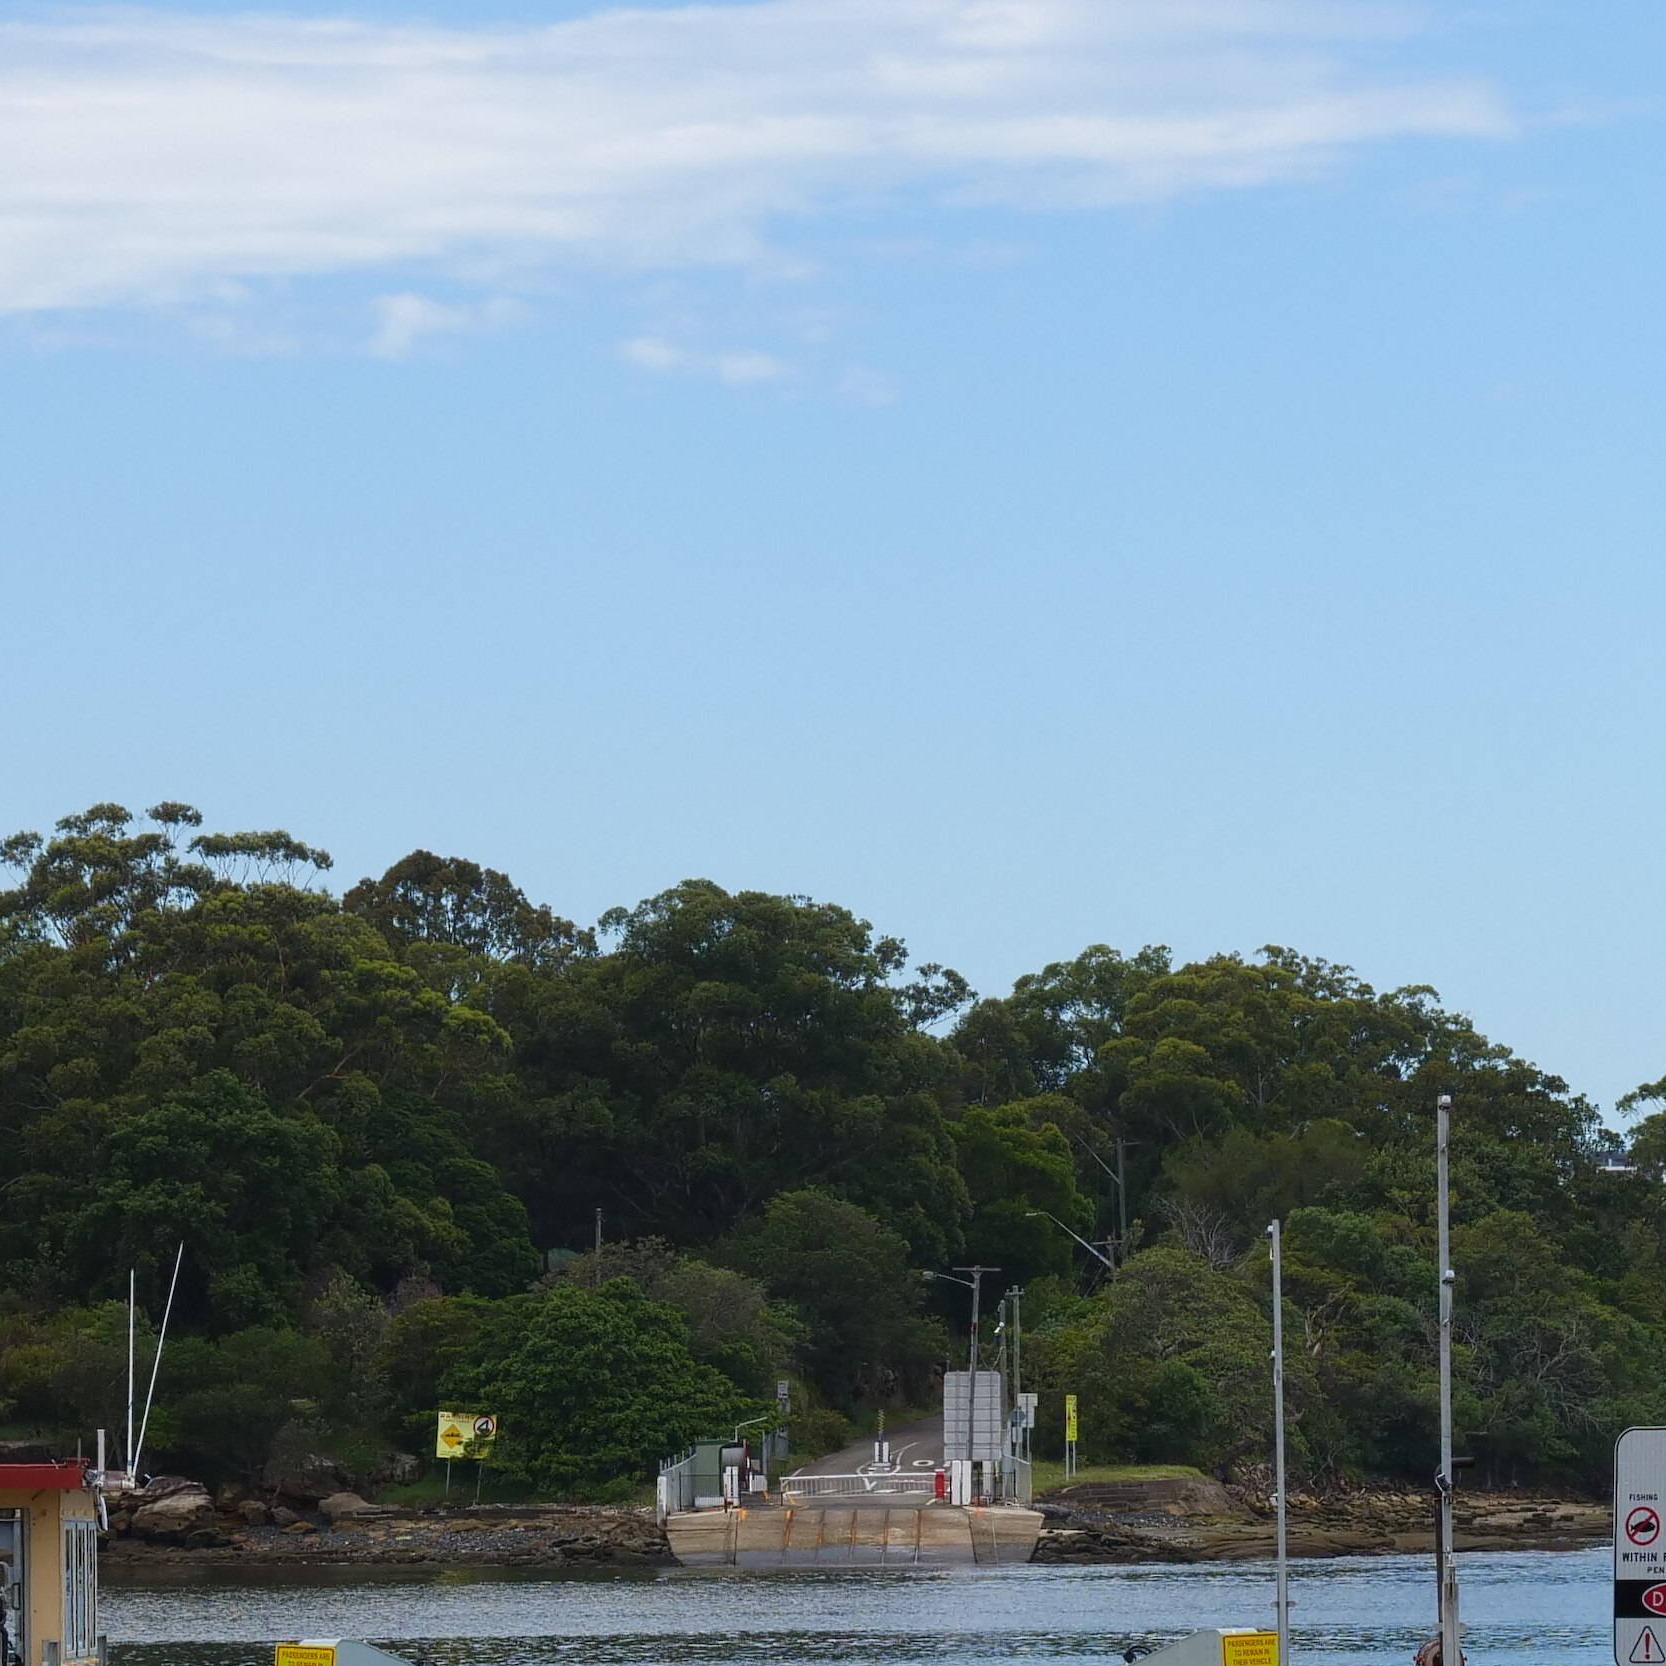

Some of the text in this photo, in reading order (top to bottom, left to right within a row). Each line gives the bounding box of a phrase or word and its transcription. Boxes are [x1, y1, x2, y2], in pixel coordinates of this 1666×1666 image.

[1629, 1493, 1658, 1501] FISHING
[1622, 1552, 1657, 1562] WITHIN
[282, 1651, 331, 1661] PASSENGERS ARE
